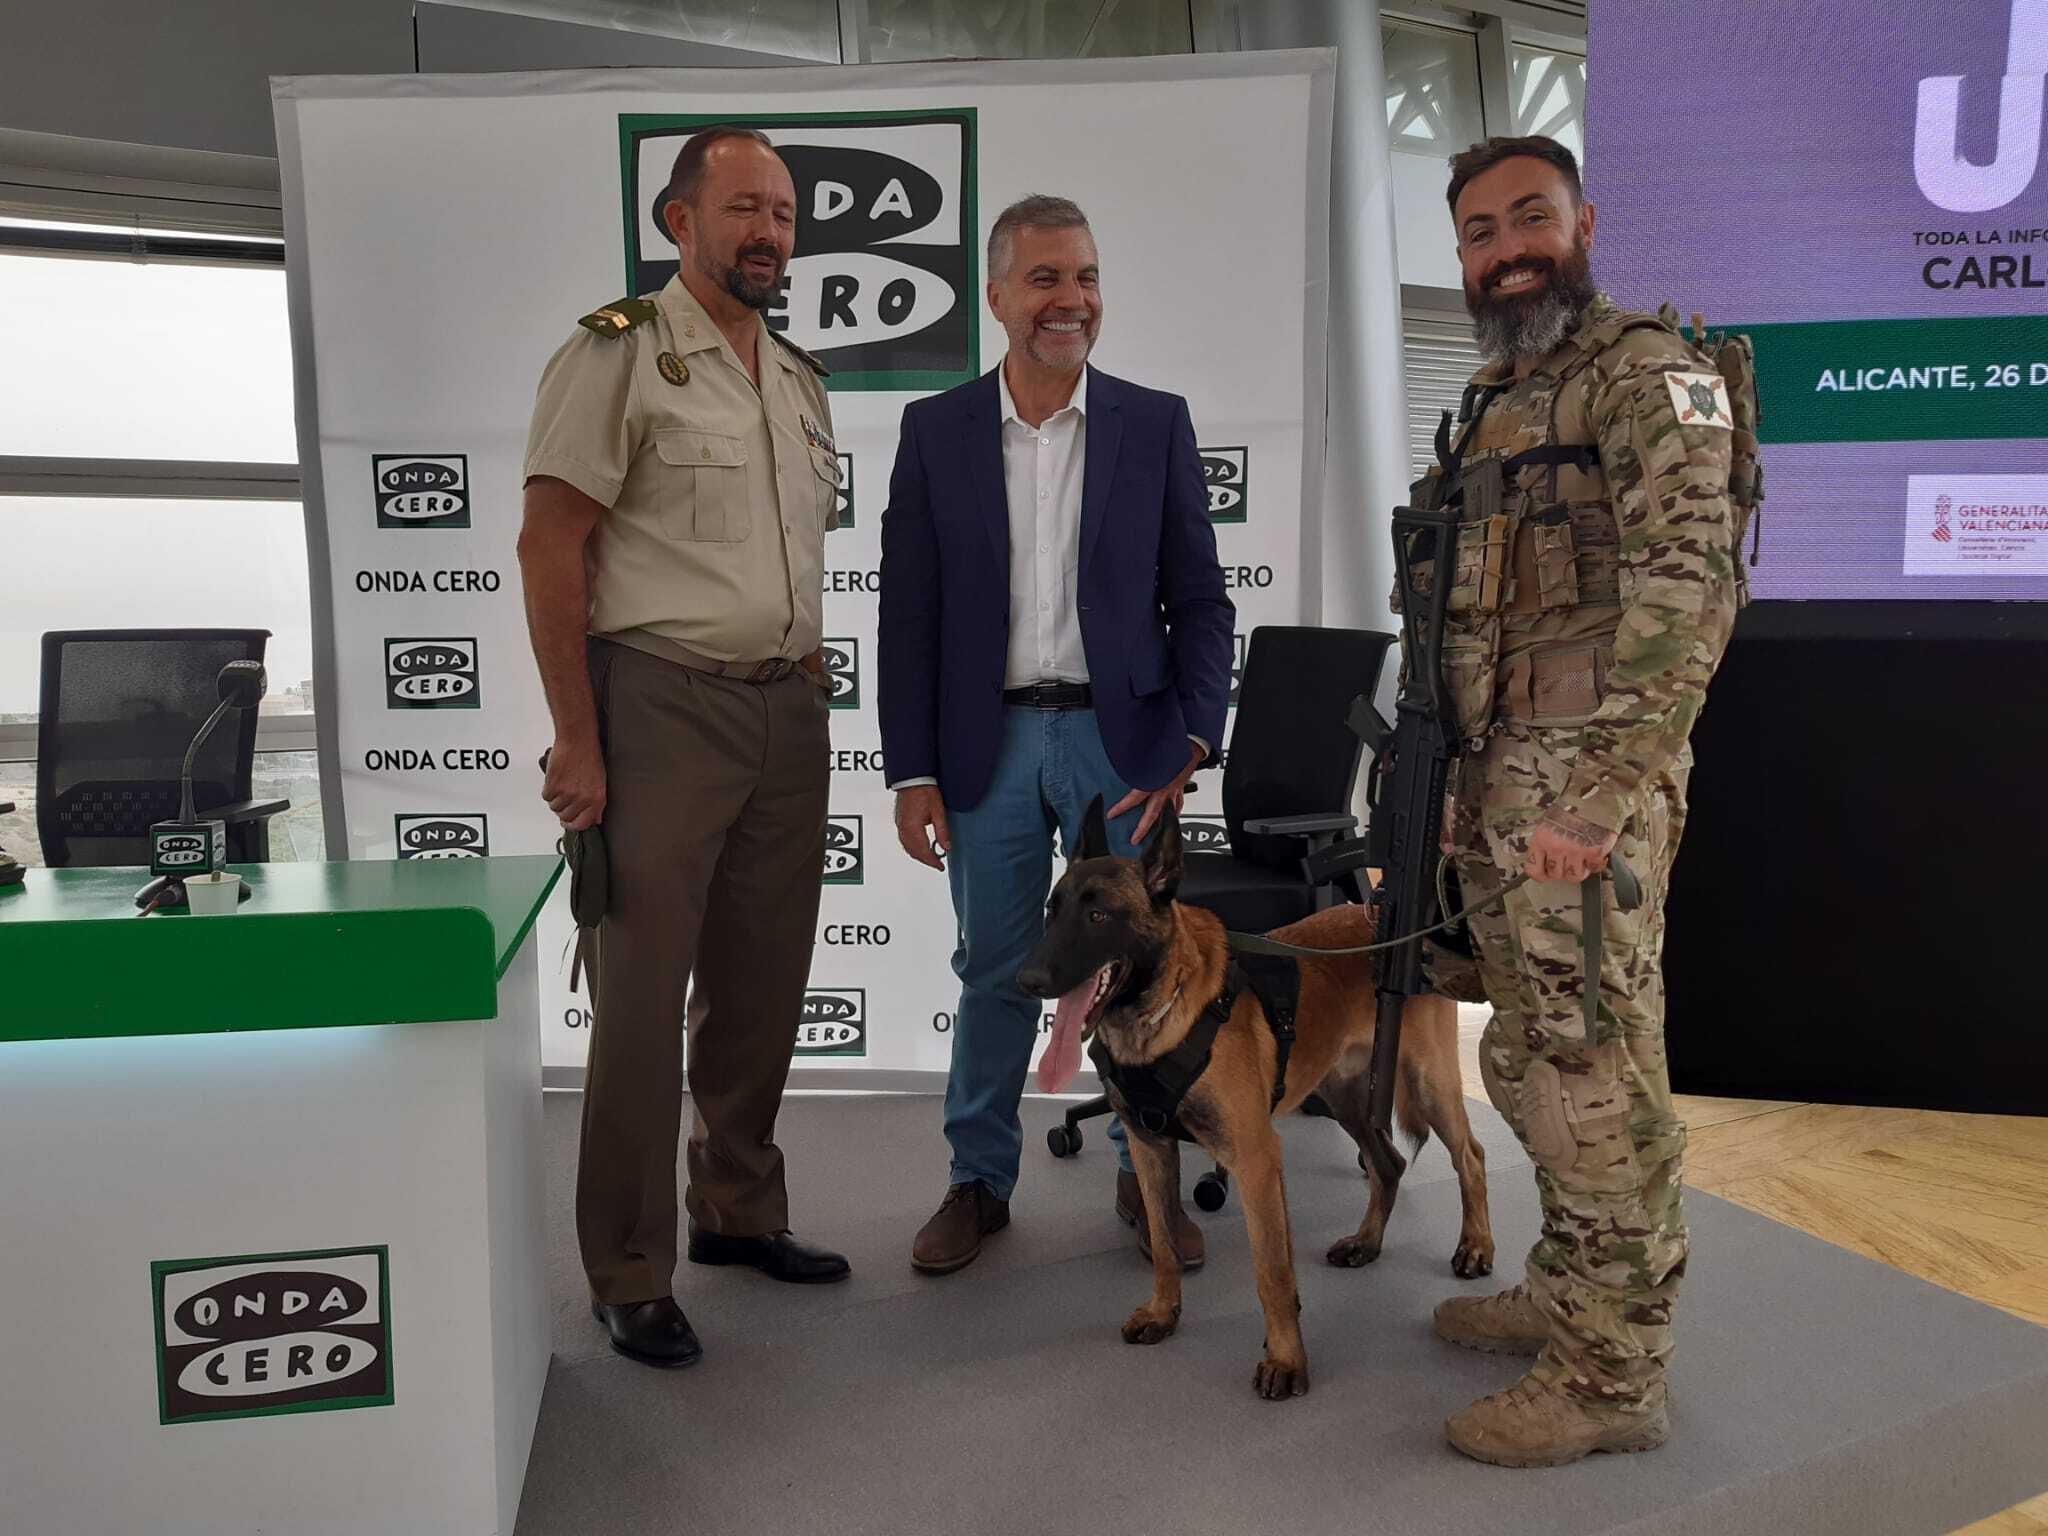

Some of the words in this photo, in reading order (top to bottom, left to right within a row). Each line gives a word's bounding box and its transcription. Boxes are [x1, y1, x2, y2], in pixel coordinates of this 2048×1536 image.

[812, 177, 914, 222] DA
[1912, 230, 1970, 246] TODA
[1976, 229, 2002, 245] LA
[1922, 255, 2048, 291] CARL
[764, 274, 917, 331] ERO
[1815, 365, 1976, 392] ALICANTE,
[1984, 364, 2021, 388] 26
[388, 471, 452, 486] ONDA
[394, 497, 454, 513] CERO
[355, 570, 427, 592] ONDA
[433, 570, 500, 592] CERO
[1223, 565, 1273, 588] ERO
[400, 654, 462, 668] ONDA
[405, 679, 463, 695] CERO
[365, 749, 436, 771] ONDA
[442, 749, 510, 771] CERO
[162, 840, 199, 849] ONDA
[411, 829, 472, 844] ONDA
[1181, 830, 1226, 843] NDA
[165, 853, 199, 862] CERO
[823, 924, 891, 946] CERO
[803, 1003, 850, 1015] NDA
[797, 1027, 850, 1042] ERO
[193, 1287, 349, 1327] ONDA
[205, 1344, 352, 1386] CERO
